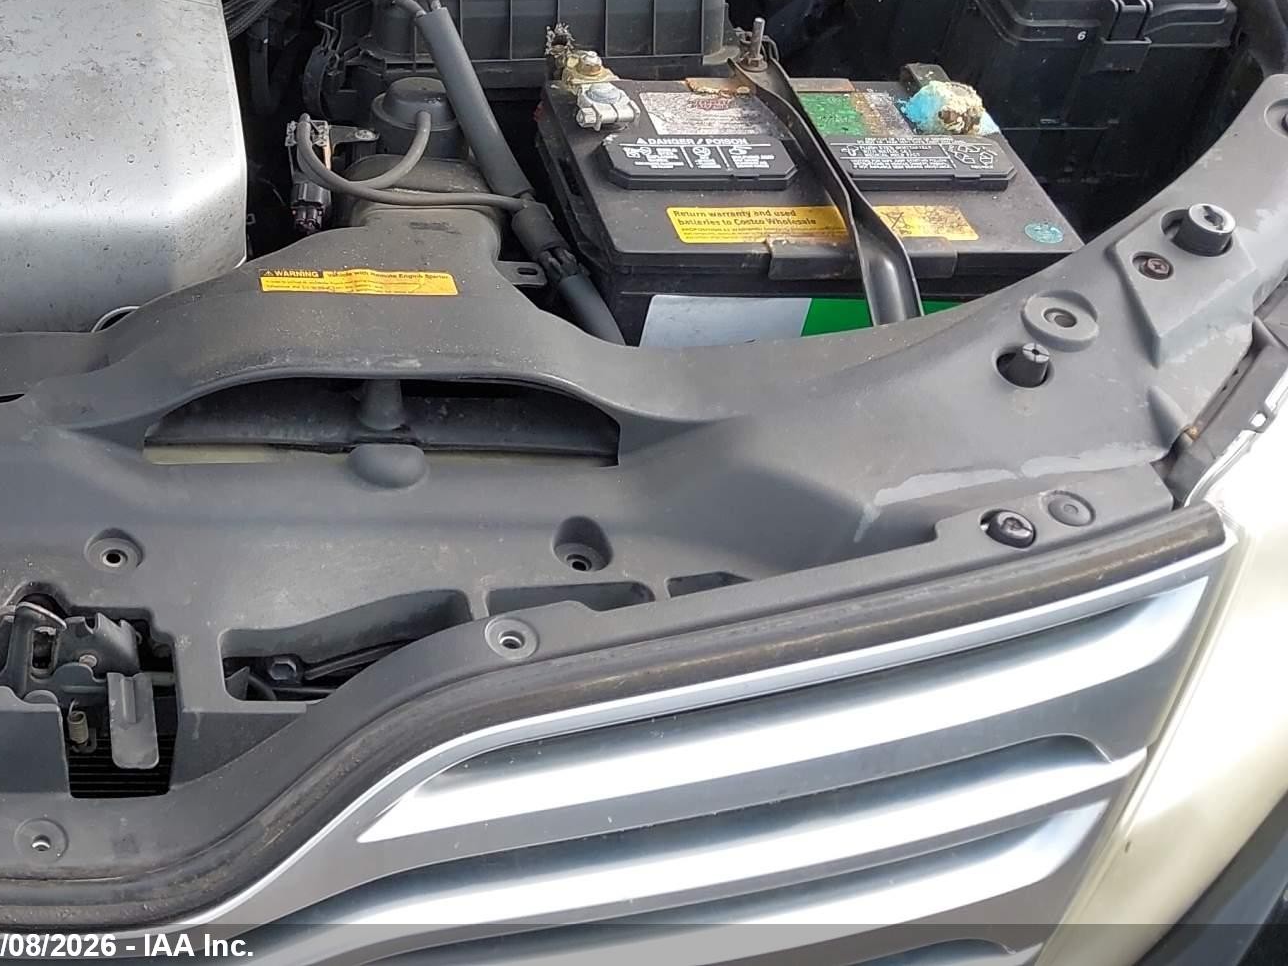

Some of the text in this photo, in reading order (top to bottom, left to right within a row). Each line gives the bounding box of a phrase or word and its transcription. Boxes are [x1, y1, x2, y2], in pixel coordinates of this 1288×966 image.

[1077, 31, 1087, 40] 6
[647, 137, 694, 145] DANGER
[705, 137, 748, 145] POISON
[673, 209, 796, 218] Return warranty and used
[678, 217, 817, 226] batteries to Costco Wholesale
[274, 270, 319, 278] WARNING
